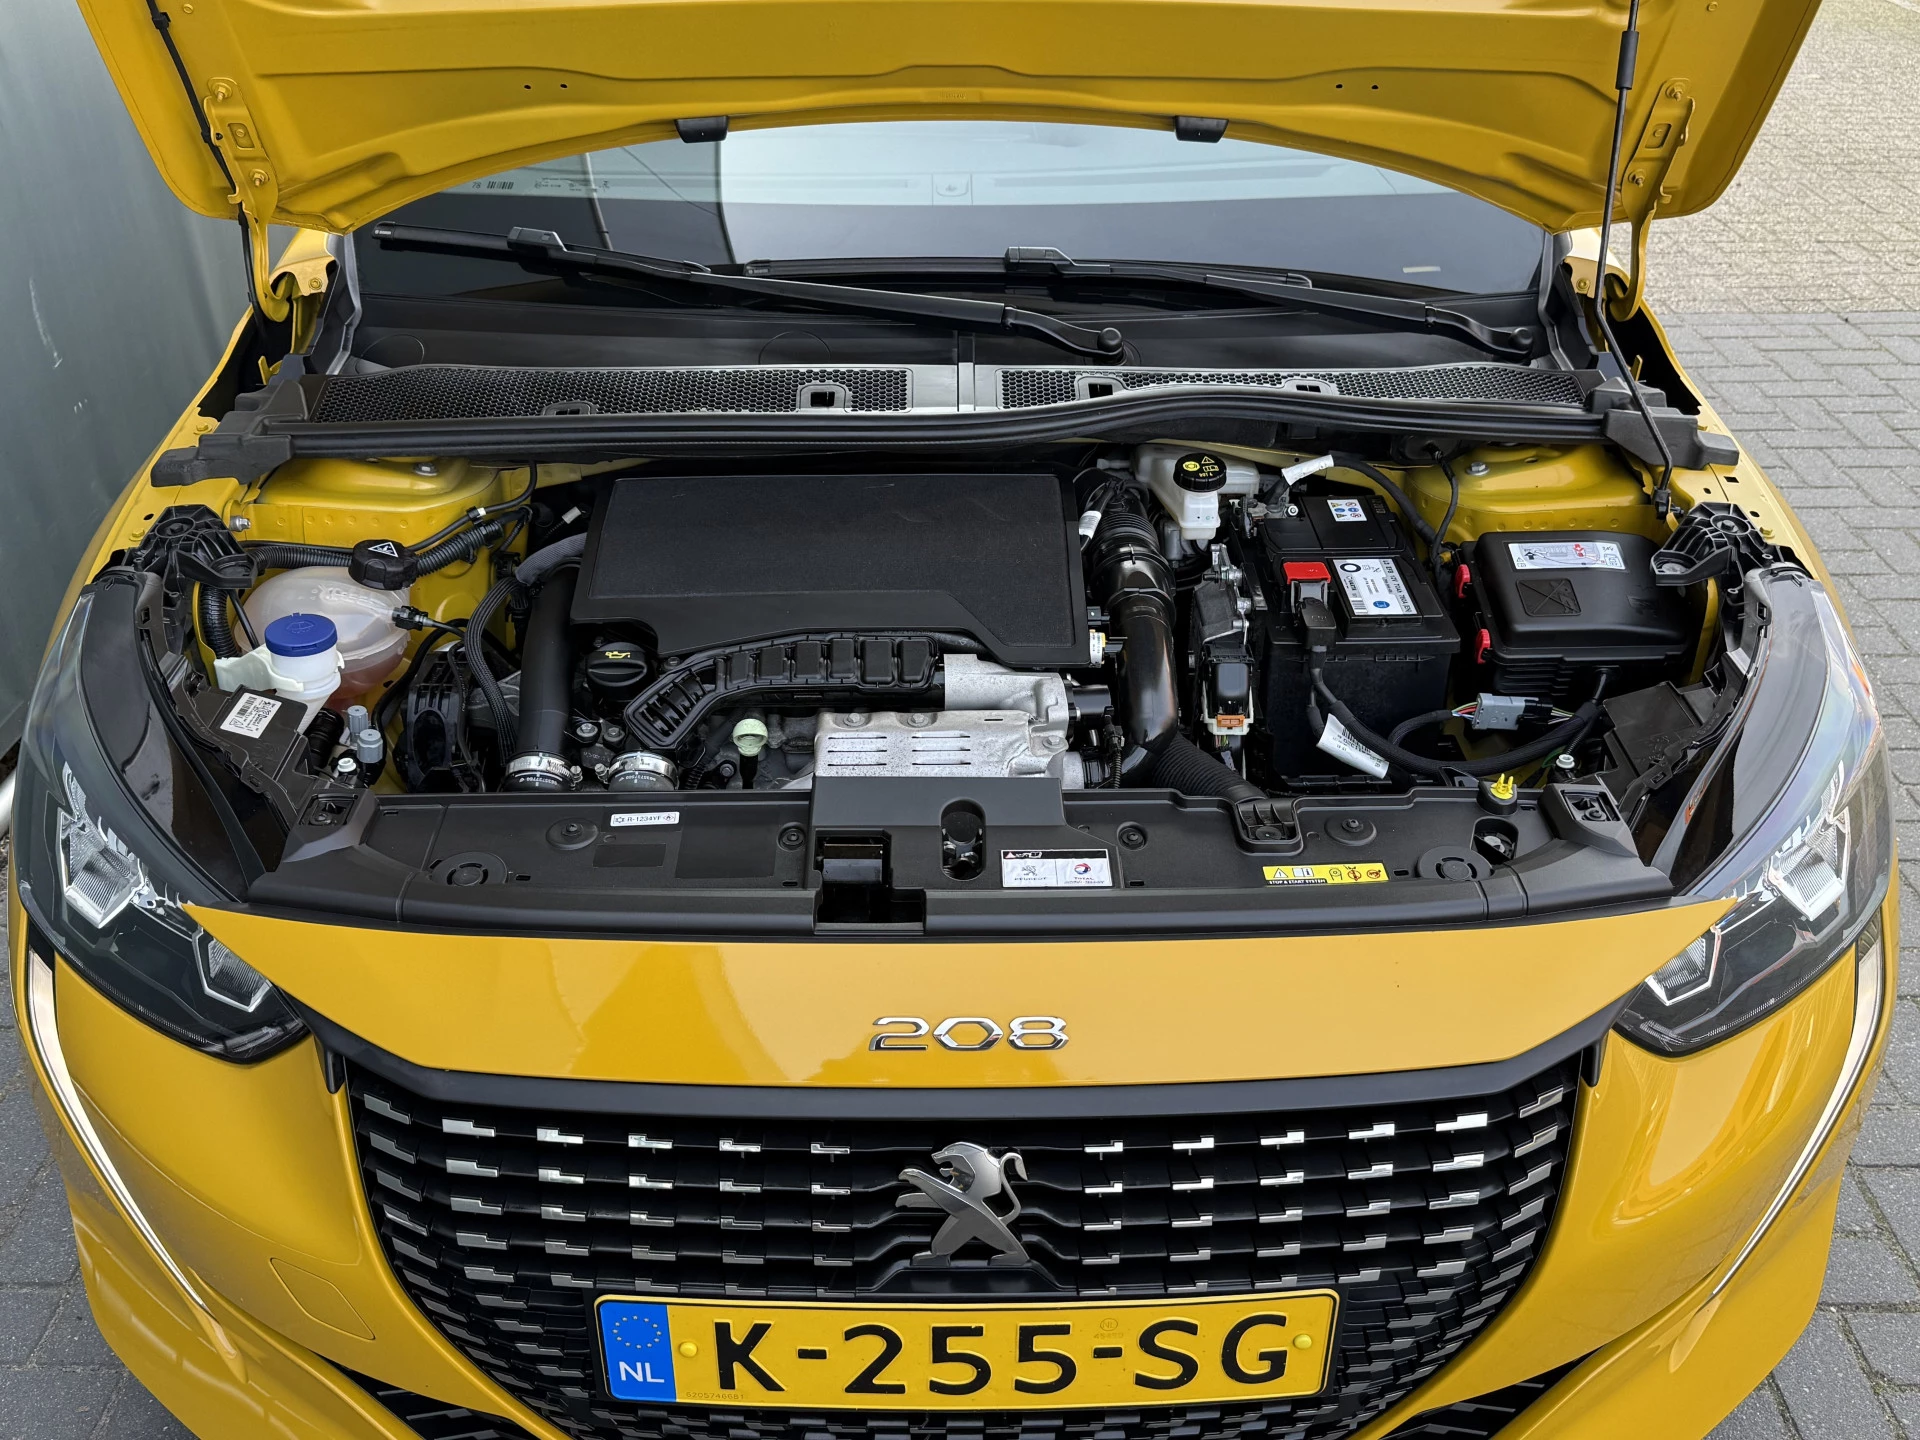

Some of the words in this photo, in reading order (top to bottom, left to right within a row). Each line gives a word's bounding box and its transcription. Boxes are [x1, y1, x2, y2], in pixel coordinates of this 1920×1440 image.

[869, 1016, 1069, 1051] 208
[714, 1313, 1288, 1395] K-255-SG
[618, 1361, 665, 1384] NL
